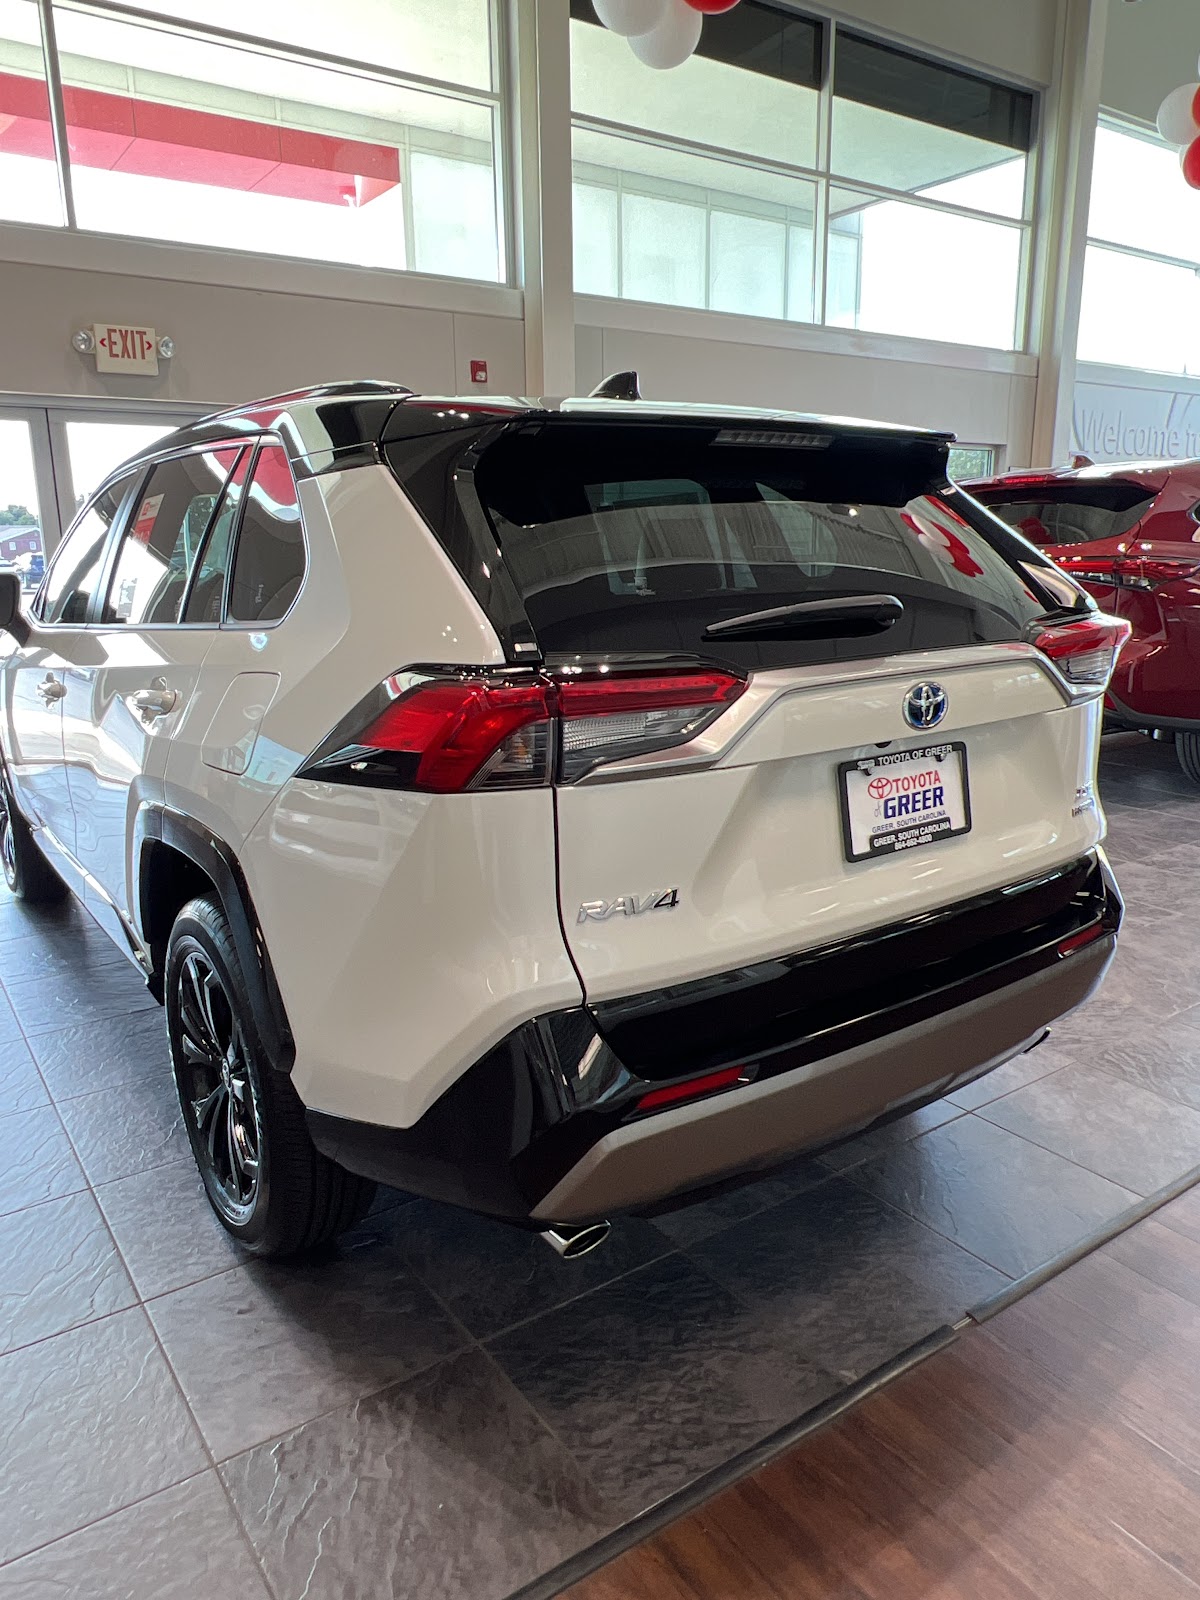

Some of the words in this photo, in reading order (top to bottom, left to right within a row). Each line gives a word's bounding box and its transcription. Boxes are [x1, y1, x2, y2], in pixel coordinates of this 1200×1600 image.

[107, 328, 147, 360] EXIT
[1081, 409, 1180, 458] Welcome
[878, 753, 911, 765] TOYOTA
[912, 750, 924, 760] OF
[925, 745, 953, 757] GREER
[892, 769, 942, 794] TOYOTA
[884, 786, 944, 819] GREER
[897, 817, 917, 828] SOUTH
[918, 809, 946, 821] CAROLINA
[897, 828, 919, 841] SOUTH
[920, 821, 951, 836] CAROLINA
[576, 887, 680, 925] RAV4
